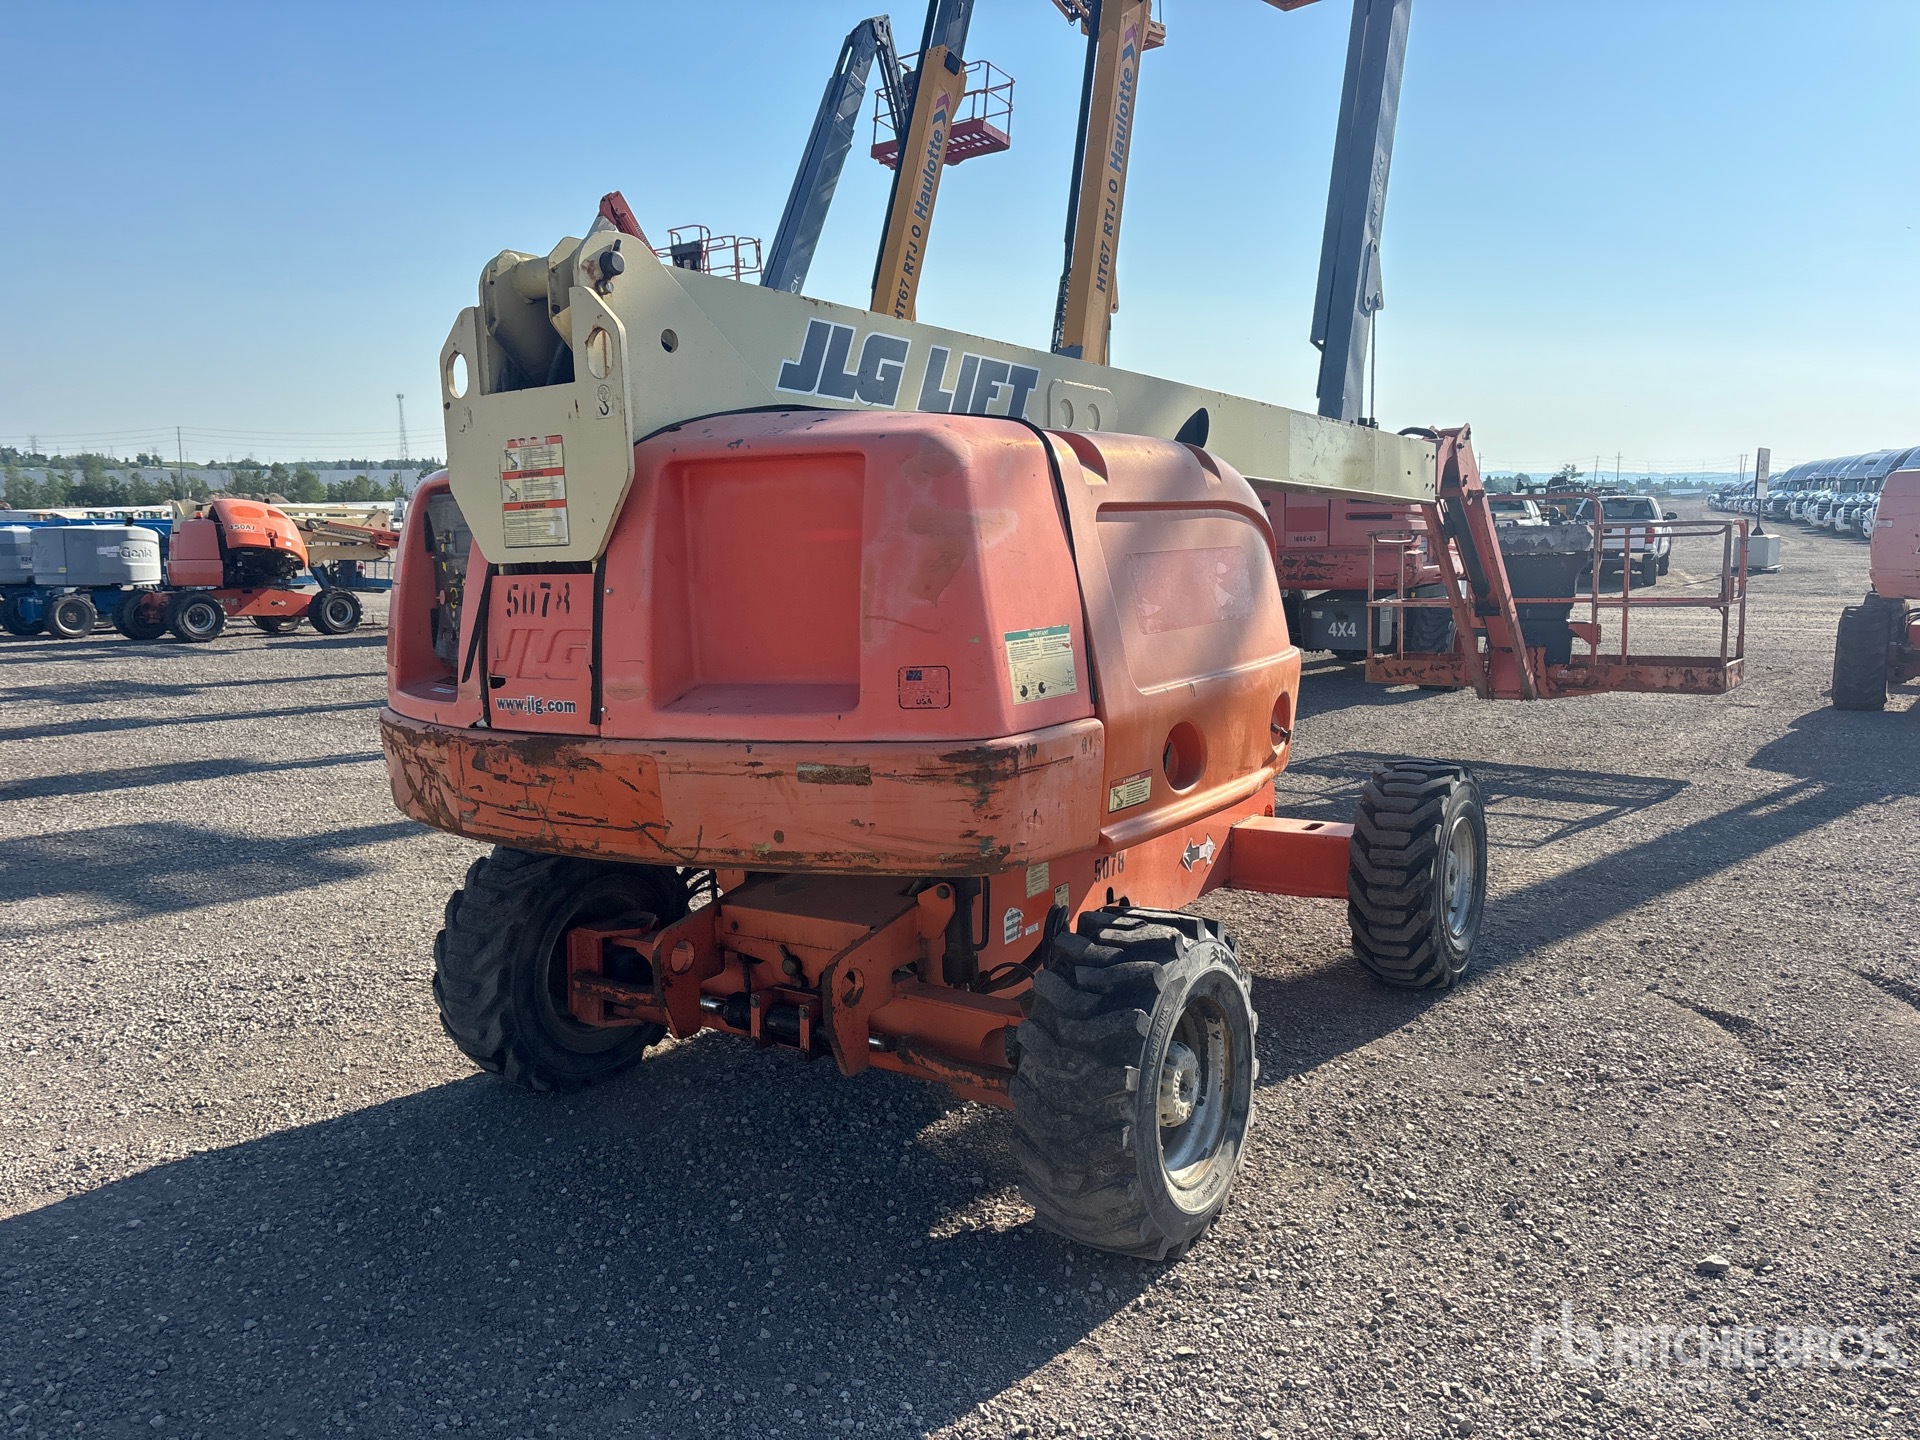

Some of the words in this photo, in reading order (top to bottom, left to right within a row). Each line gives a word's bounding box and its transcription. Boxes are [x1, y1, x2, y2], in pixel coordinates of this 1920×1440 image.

[1096, 239, 1110, 293] HT67
[1103, 198, 1116, 237] RTJ
[1110, 67, 1133, 174] Haulotte
[903, 240, 918, 276] RTJ
[914, 129, 943, 220] Haulotte
[775, 317, 912, 409] JLG
[915, 344, 1041, 420] LIFT
[228, 523, 256, 531] 450AJ
[121, 545, 152, 560] Genie
[506, 582, 570, 617] 5078
[1328, 622, 1357, 637] 4X4
[492, 628, 592, 681] JLG
[496, 696, 576, 715] www.jlg.com
[1094, 851, 1125, 883] 5078
